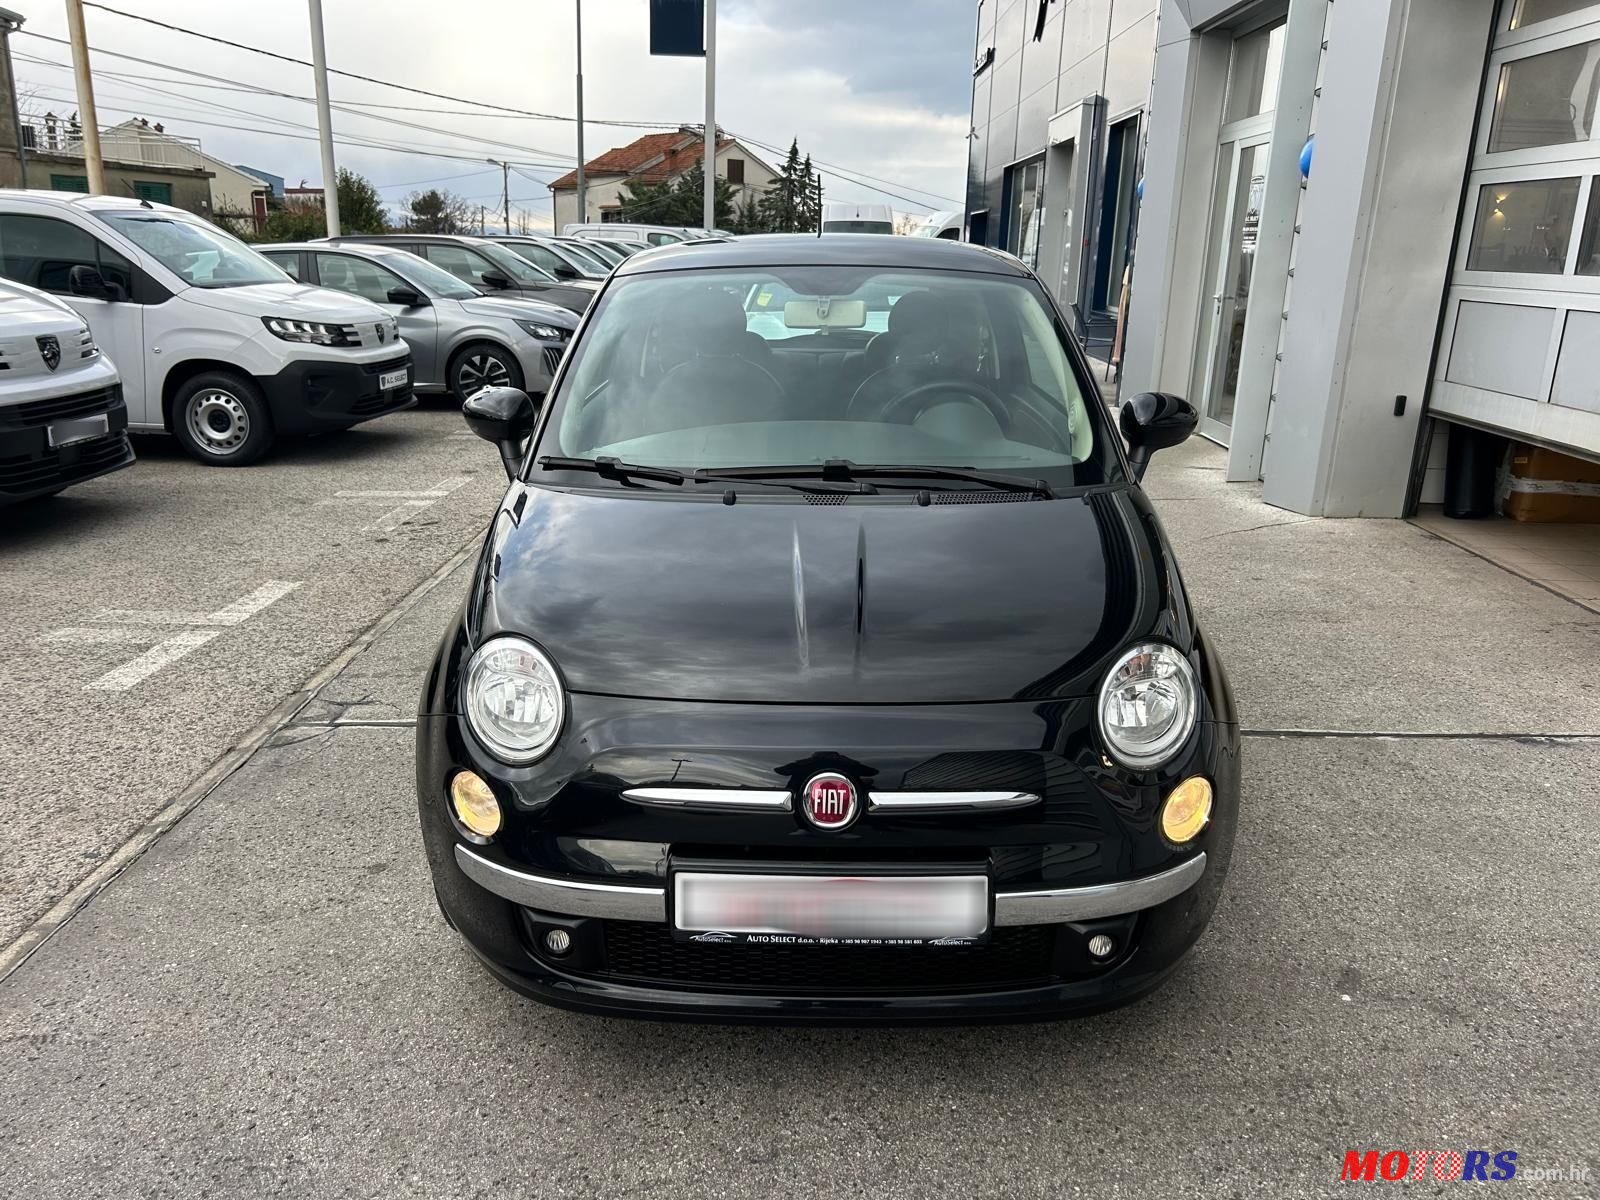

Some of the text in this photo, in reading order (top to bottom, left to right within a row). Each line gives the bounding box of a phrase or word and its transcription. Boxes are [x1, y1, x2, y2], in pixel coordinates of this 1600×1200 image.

[814, 788, 846, 814] FIAT
[747, 934, 769, 943] AUTO
[770, 935, 796, 943] SELECT
[820, 936, 838, 945] Rijeka
